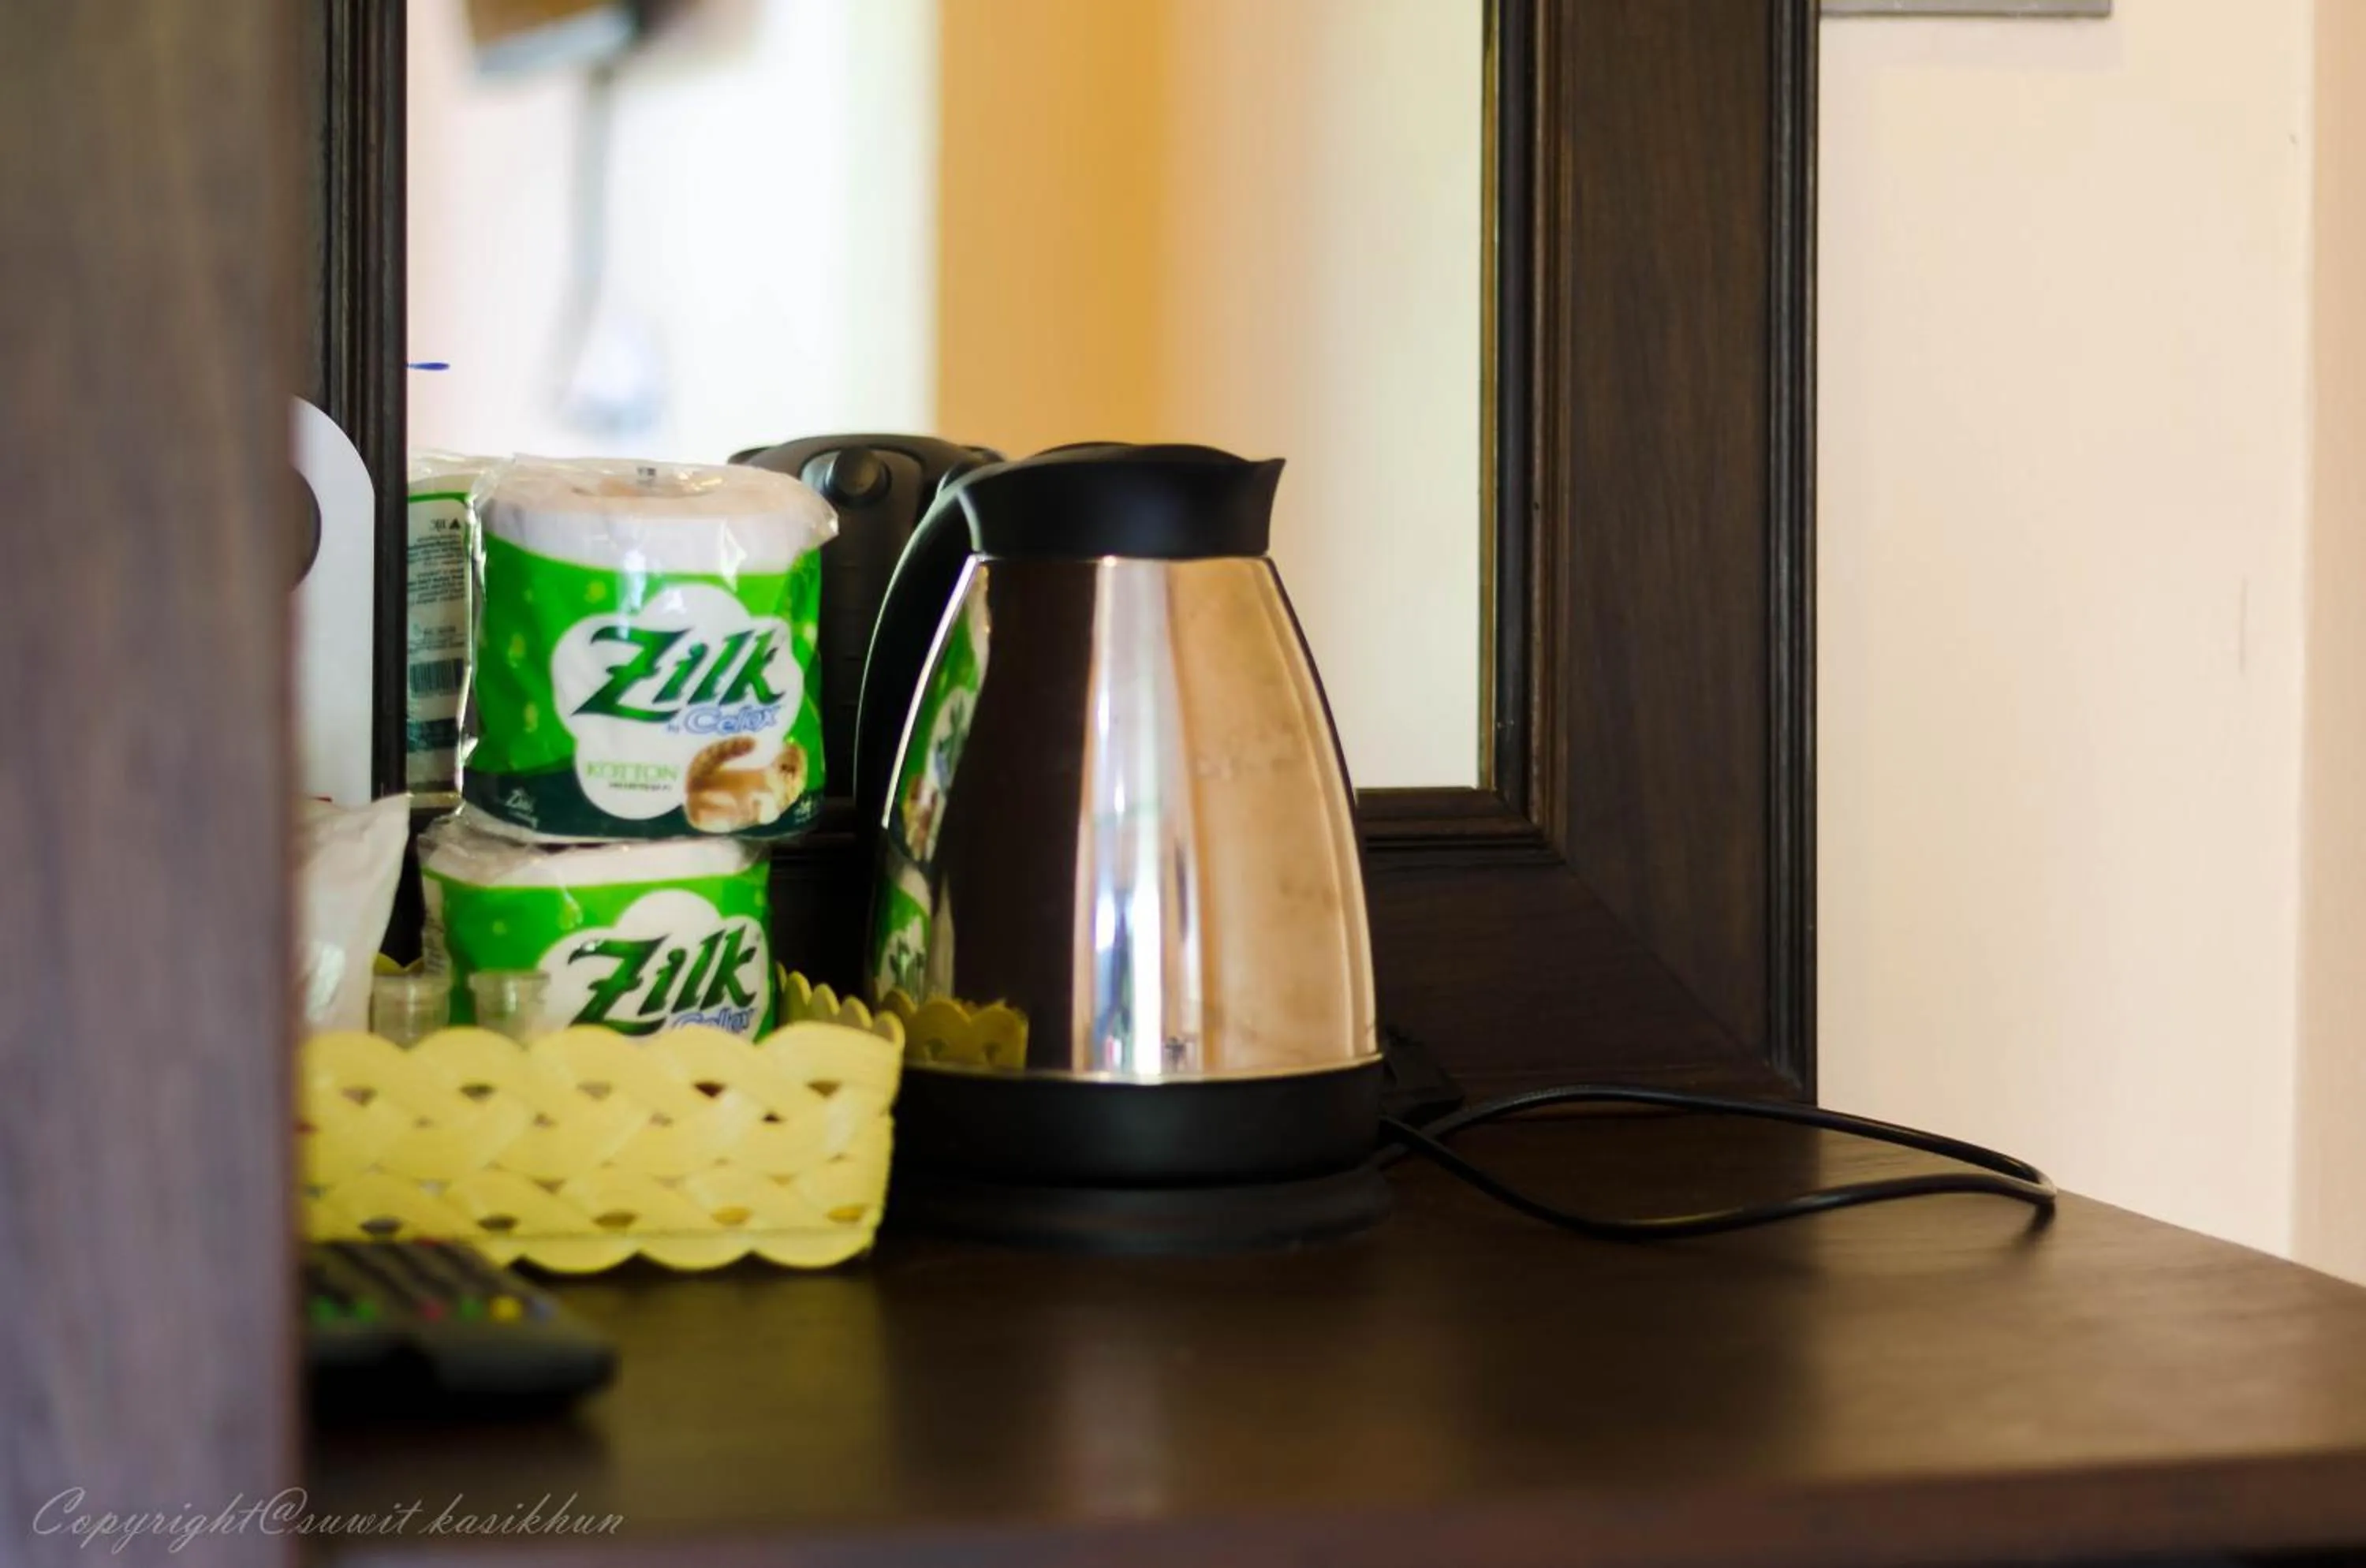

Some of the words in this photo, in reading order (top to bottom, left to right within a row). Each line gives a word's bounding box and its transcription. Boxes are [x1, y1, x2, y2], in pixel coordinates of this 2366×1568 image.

[572, 625, 786, 722] Zilk
[585, 761, 679, 781] KOTTON
[568, 925, 757, 1036] Zilk
